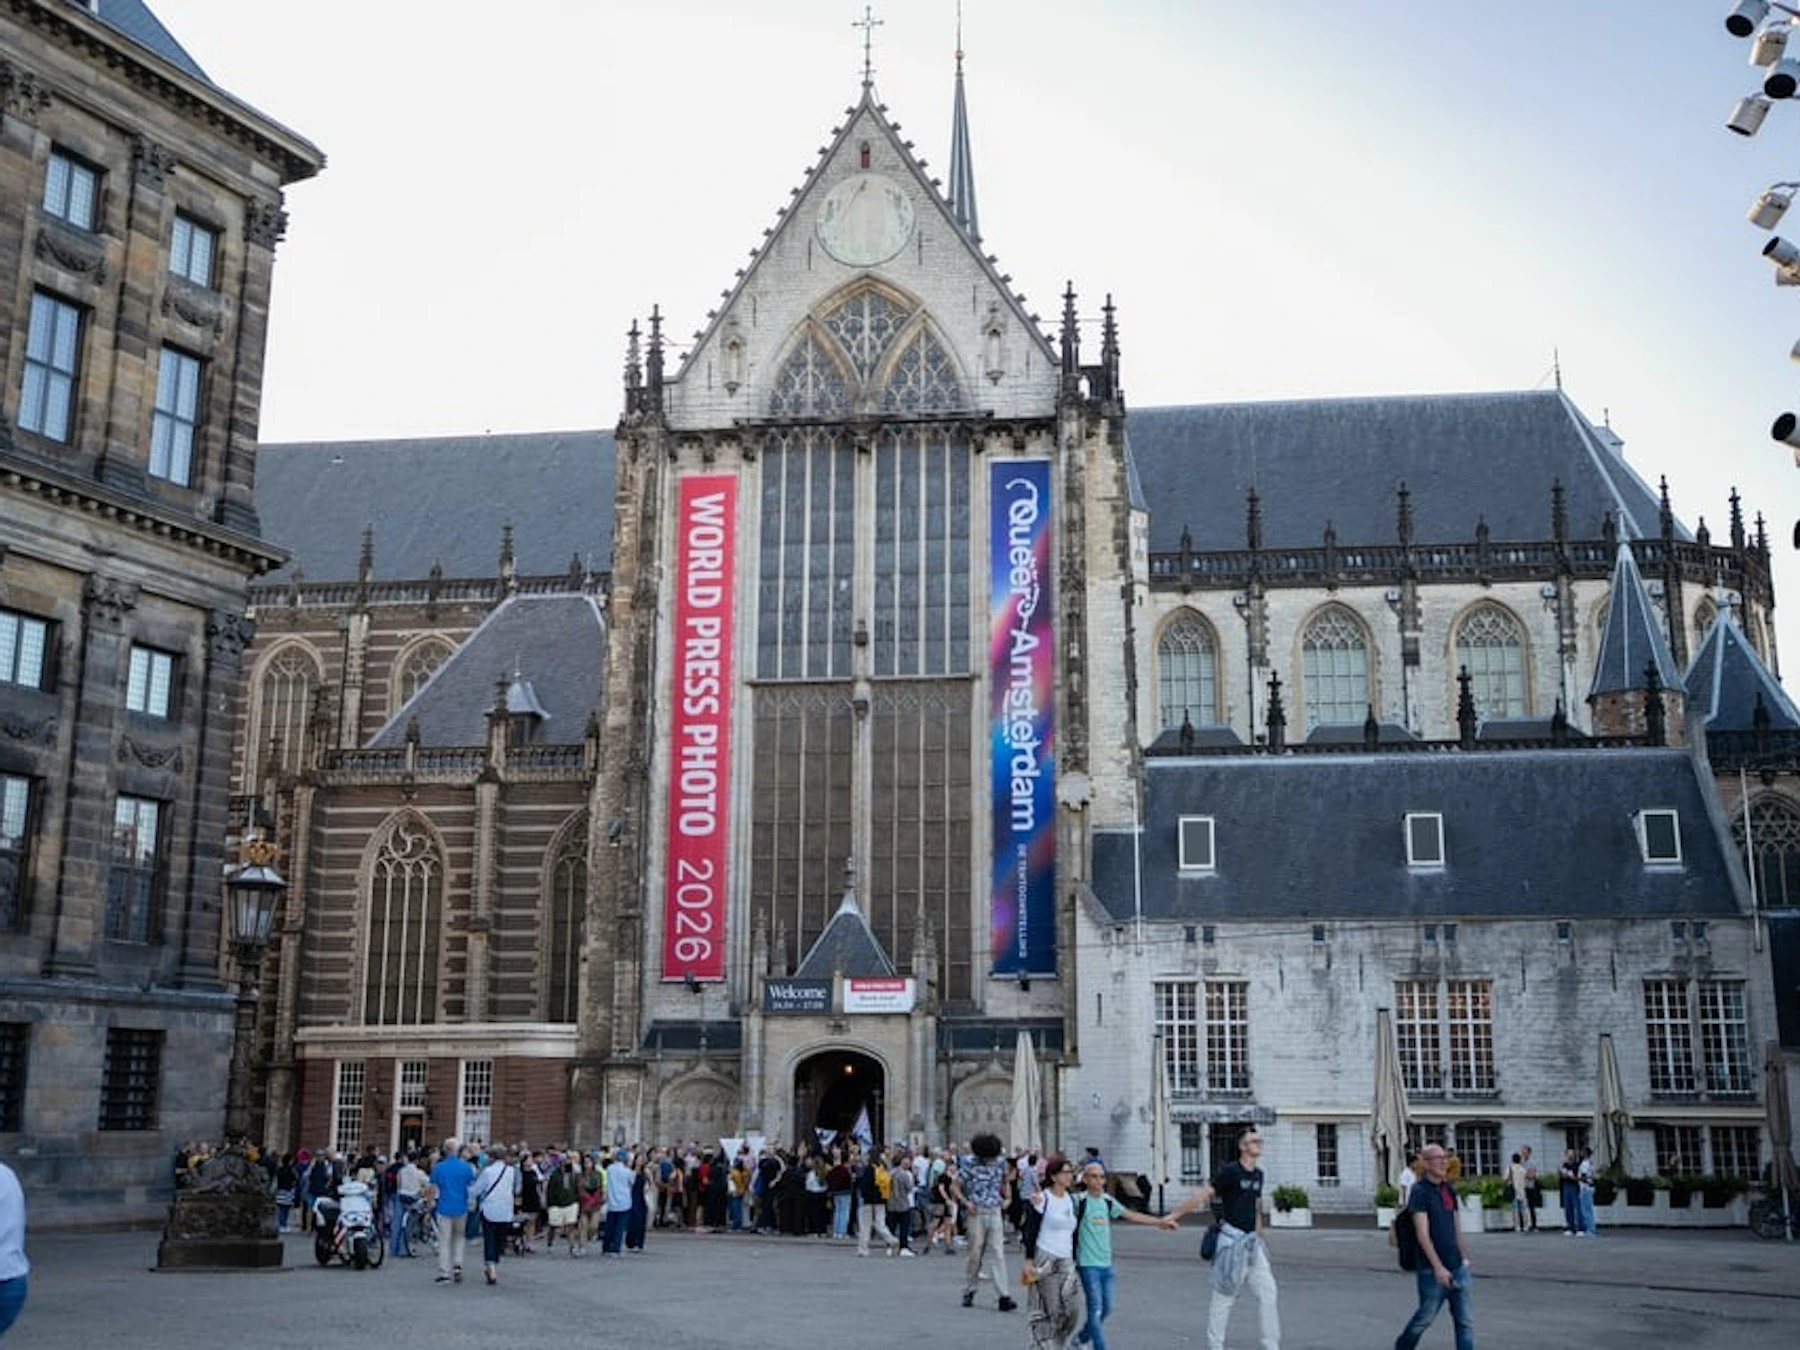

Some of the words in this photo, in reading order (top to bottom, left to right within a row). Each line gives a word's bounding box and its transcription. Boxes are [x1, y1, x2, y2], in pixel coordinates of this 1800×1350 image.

[687, 492, 726, 609] WORLD
[1008, 479, 1039, 612] Queer
[683, 616, 721, 717] PRESS
[679, 724, 718, 837] PHOTO
[1008, 629, 1041, 831] Amsterdam
[674, 859, 714, 962] 2026
[768, 984, 827, 999] Welcome
